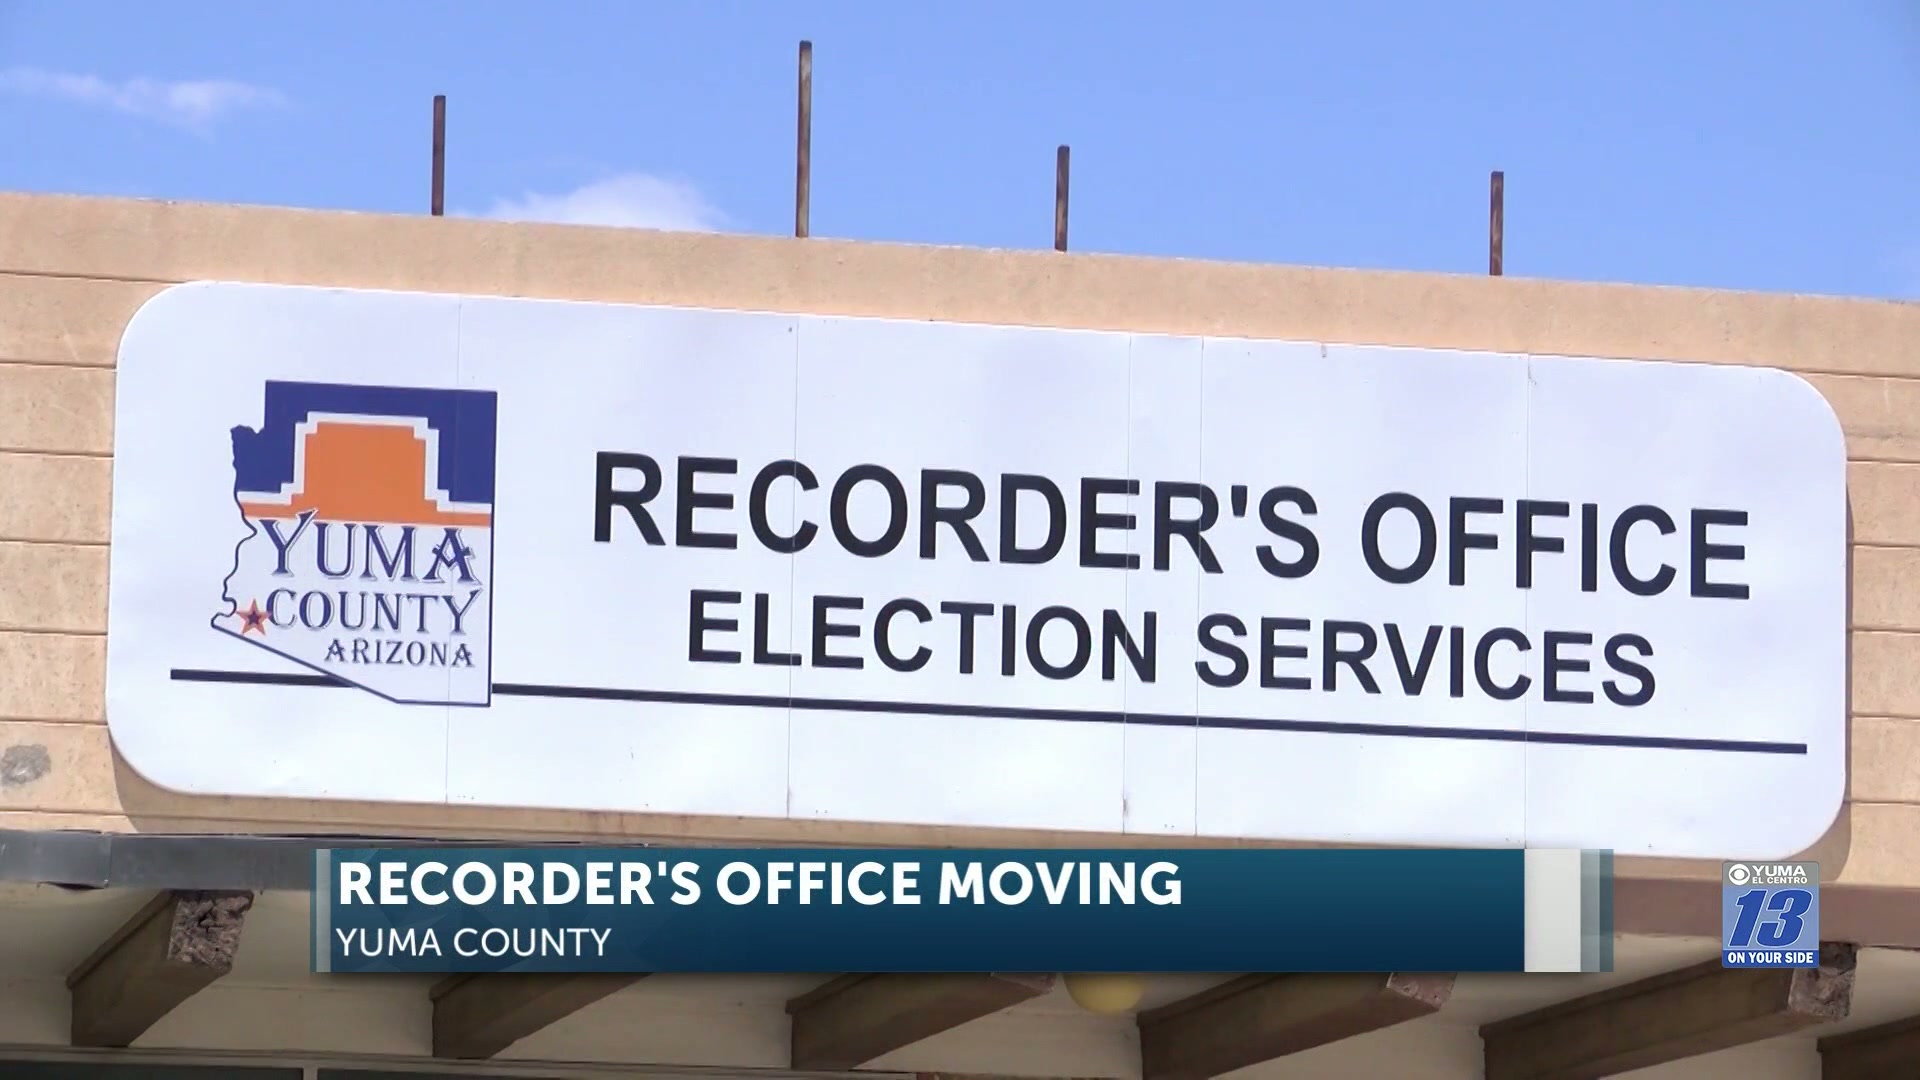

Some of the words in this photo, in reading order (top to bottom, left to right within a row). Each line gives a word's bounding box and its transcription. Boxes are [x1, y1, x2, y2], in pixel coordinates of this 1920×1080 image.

[259, 507, 482, 585] YUMA
[594, 451, 1320, 579] RECORDER'S
[1361, 492, 1750, 600] OFFICE
[265, 587, 483, 635] COUNTY
[688, 589, 1157, 683] ELECTION
[1194, 613, 1656, 707] SERVICES
[324, 638, 474, 667] ARIZONA
